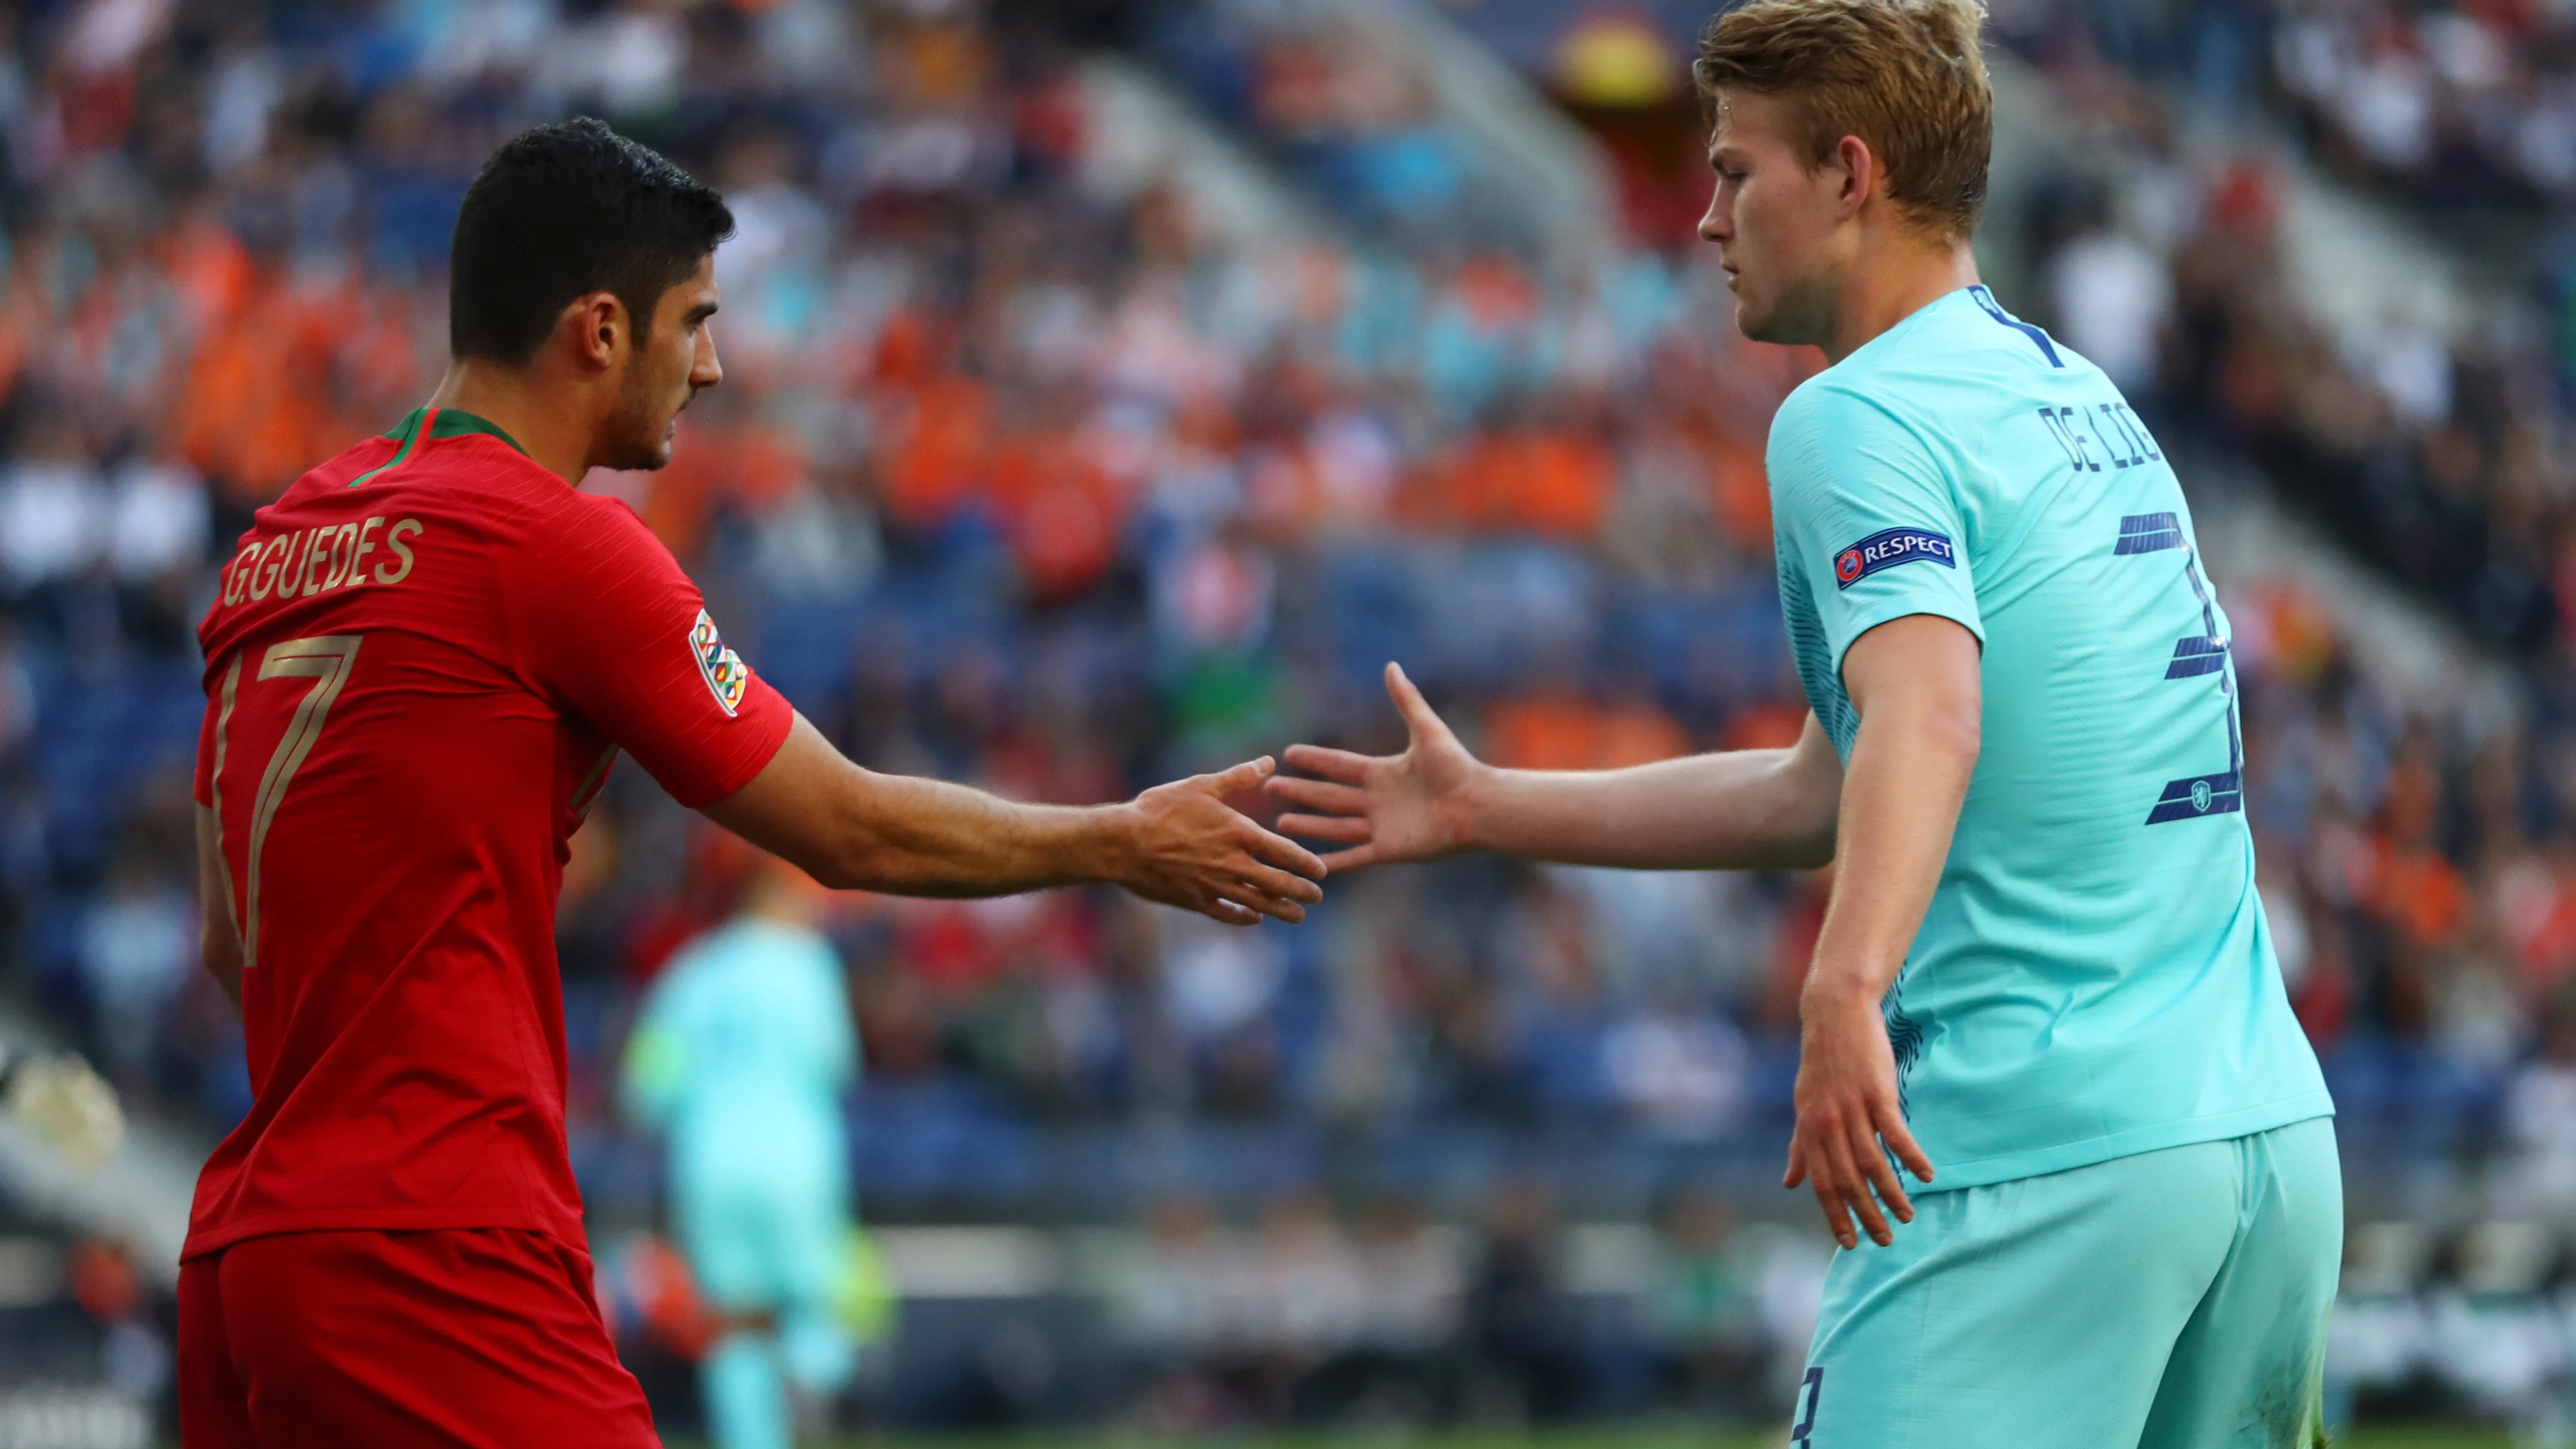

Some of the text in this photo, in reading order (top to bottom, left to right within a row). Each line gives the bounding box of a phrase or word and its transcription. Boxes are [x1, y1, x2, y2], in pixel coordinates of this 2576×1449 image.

[2038, 407, 2101, 472] DE
[1863, 535, 1952, 564] RESPECT
[2114, 512, 2244, 826] 3
